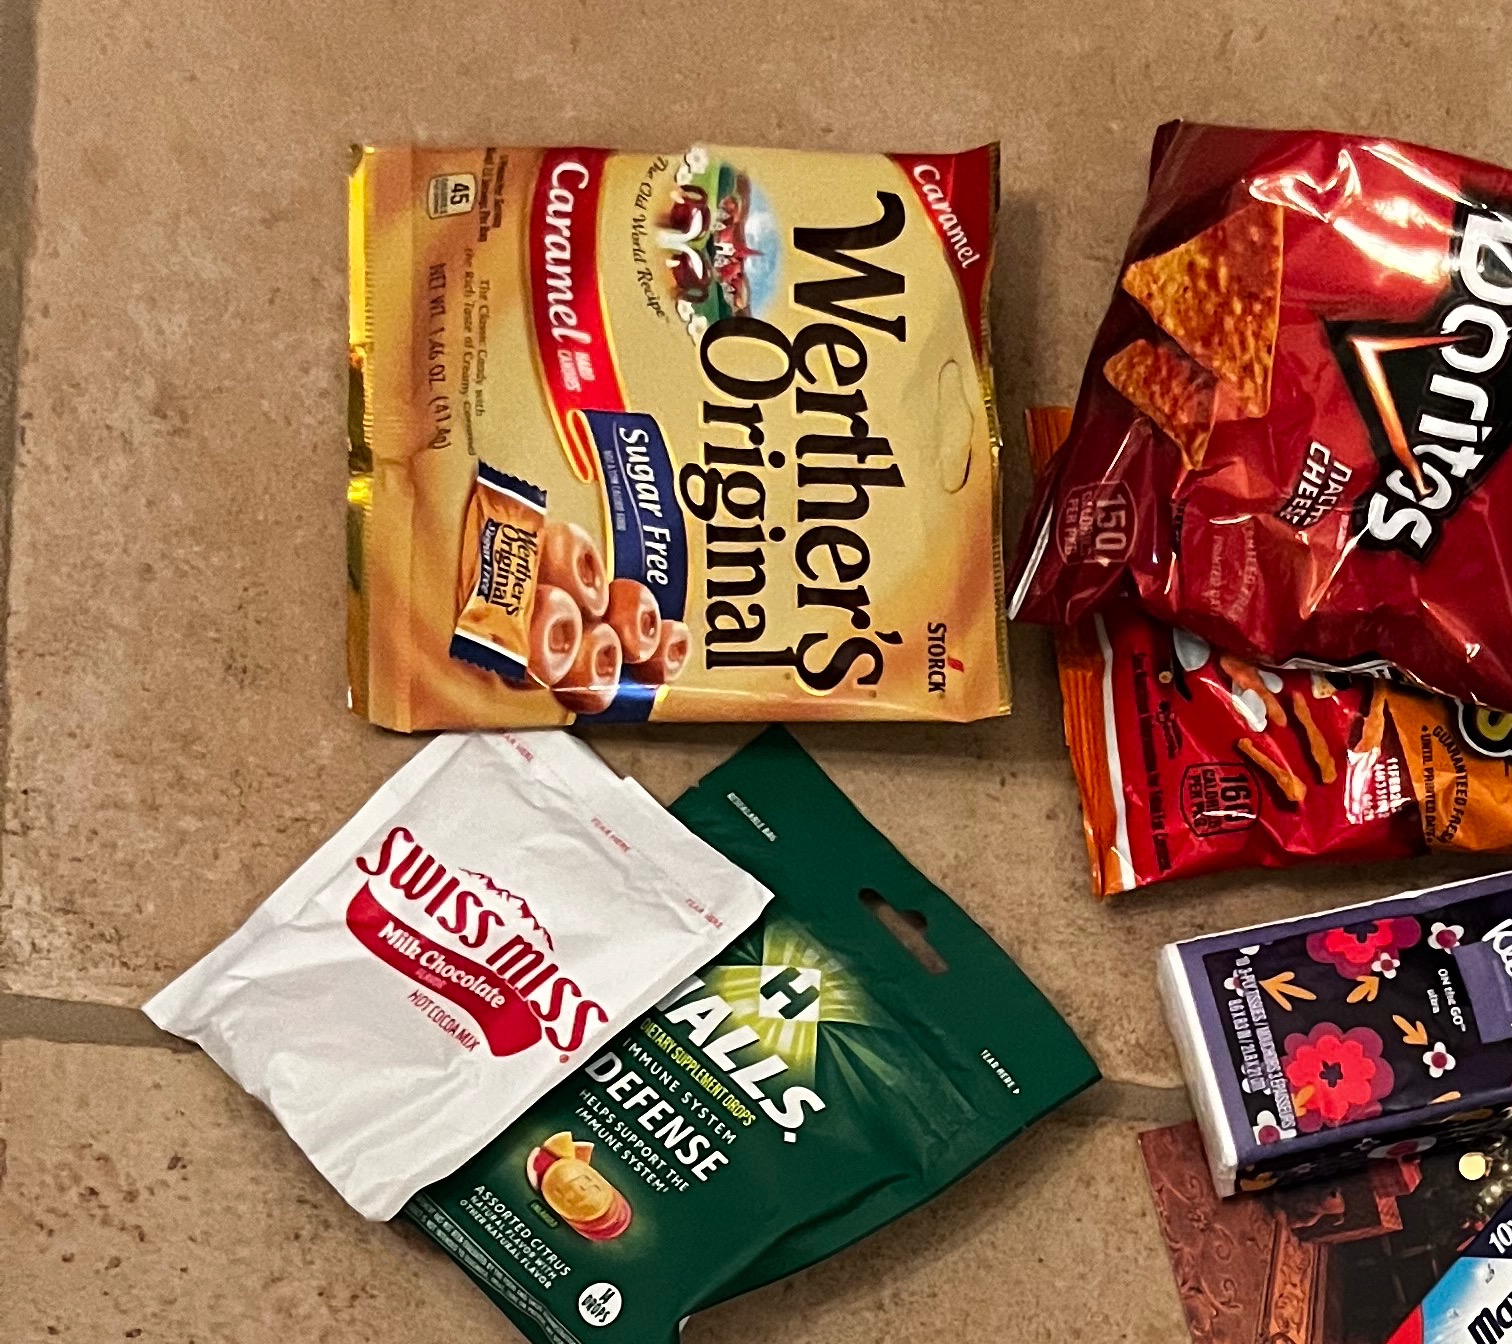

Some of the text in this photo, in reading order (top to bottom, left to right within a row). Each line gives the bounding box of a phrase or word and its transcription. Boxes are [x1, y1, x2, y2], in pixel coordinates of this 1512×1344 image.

[449, 182, 469, 205] 45
[634, 181, 652, 210] Old
[646, 155, 668, 179] The
[544, 162, 590, 342] Caramel
[631, 215, 647, 263] World
[911, 165, 977, 268] Caramel
[794, 196, 904, 686] Werther's
[616, 426, 668, 586] Sugar Free
[678, 317, 795, 666] Original
[1095, 494, 1127, 550] 150
[486, 522, 524, 607] Original
[927, 622, 946, 692] STORCK
[357, 827, 606, 1050] SWISS MISS
[378, 921, 504, 1007] Milk Chocolate
[407, 989, 480, 1051] HOT COCOA MIX
[588, 1053, 727, 1179] DEFENSE
[624, 1040, 736, 1144] IMMUNE SYSTEM
[670, 1046, 727, 1099] SUPPLEMENT
[721, 1093, 756, 1126] DROPS
[575, 1107, 623, 1151] IMMUNE
[579, 1090, 689, 1191] HELPS SUPPORT THE
[468, 1195, 505, 1230] NATURAL
[504, 1228, 536, 1258] FLAVOR
[534, 1257, 557, 1279] WITH
[474, 1185, 531, 1238] ASSORTED
[528, 1238, 571, 1275] CITRUS
[484, 1223, 524, 1259] NATURAL
[519, 1257, 551, 1288] FLAVOR
[581, 1294, 610, 1322] DROPS
